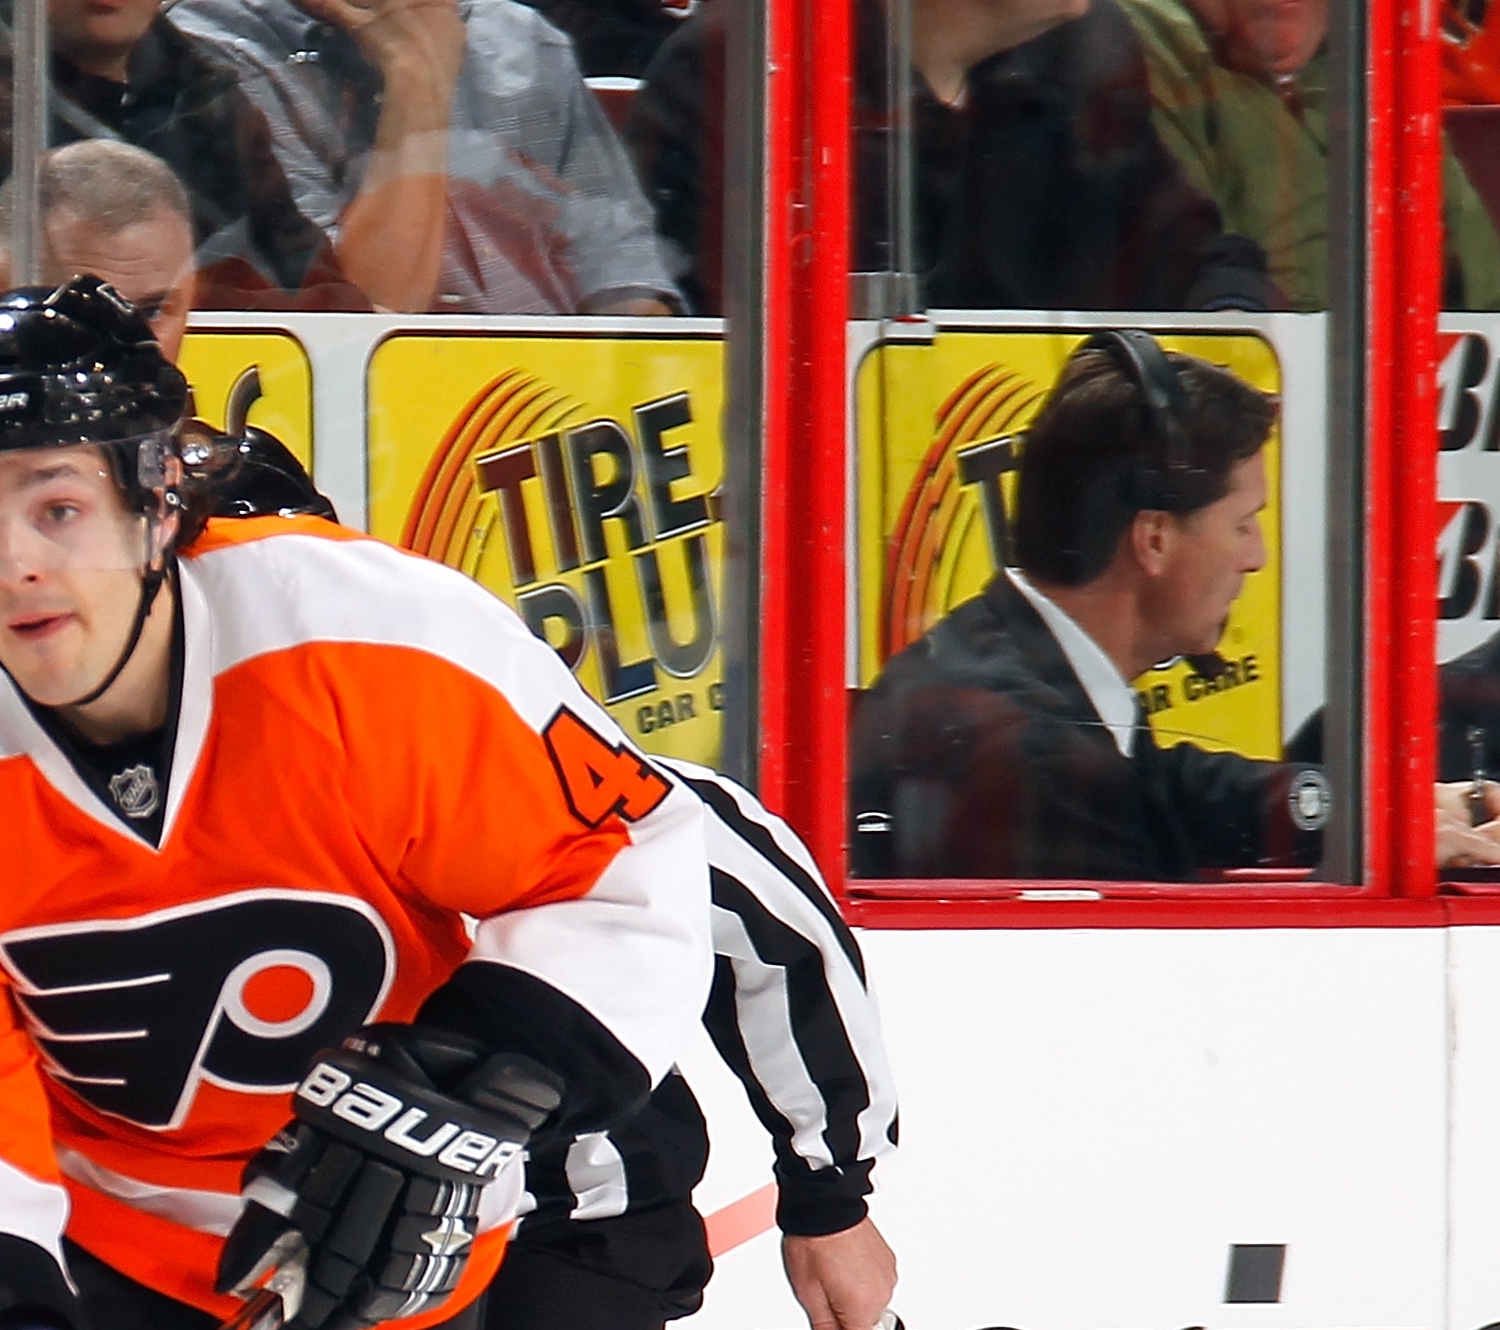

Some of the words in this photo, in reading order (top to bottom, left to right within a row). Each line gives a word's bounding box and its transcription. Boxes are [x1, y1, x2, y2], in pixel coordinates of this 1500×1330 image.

[1436, 332, 1500, 452] B
[1436, 501, 1500, 621] B
[541, 702, 675, 829] 4
[638, 692, 697, 734] CAR
[296, 1062, 530, 1179] BAUER
